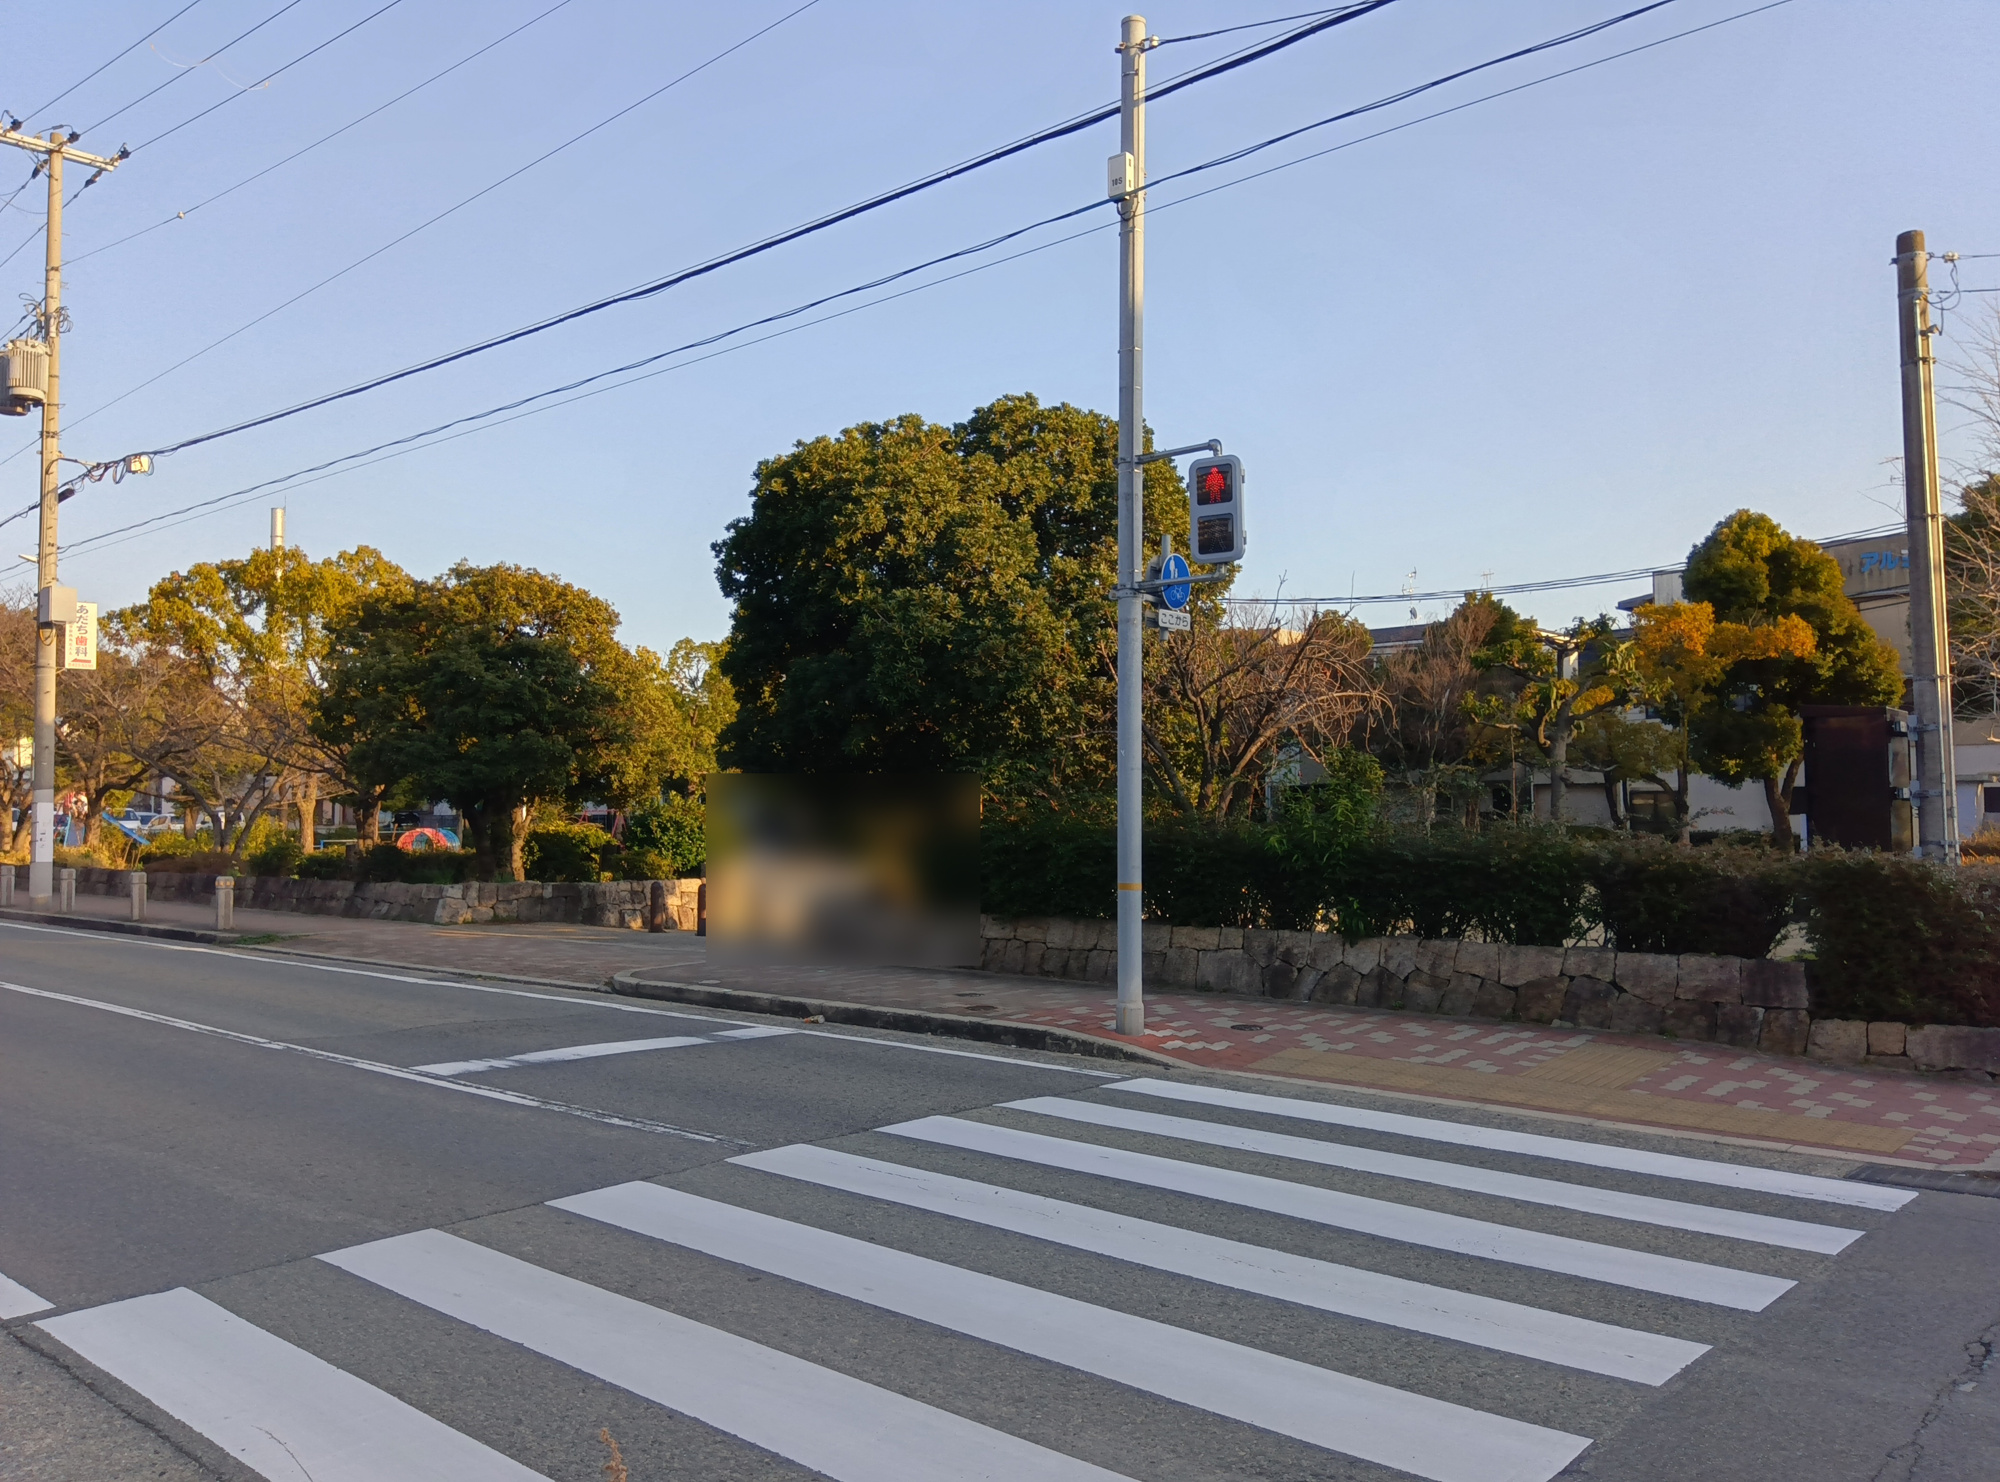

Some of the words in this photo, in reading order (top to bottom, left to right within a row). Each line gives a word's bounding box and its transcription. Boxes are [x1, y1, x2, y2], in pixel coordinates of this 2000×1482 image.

[75, 604, 89, 657] あだち歯科
[1160, 613, 1189, 628] ここから
